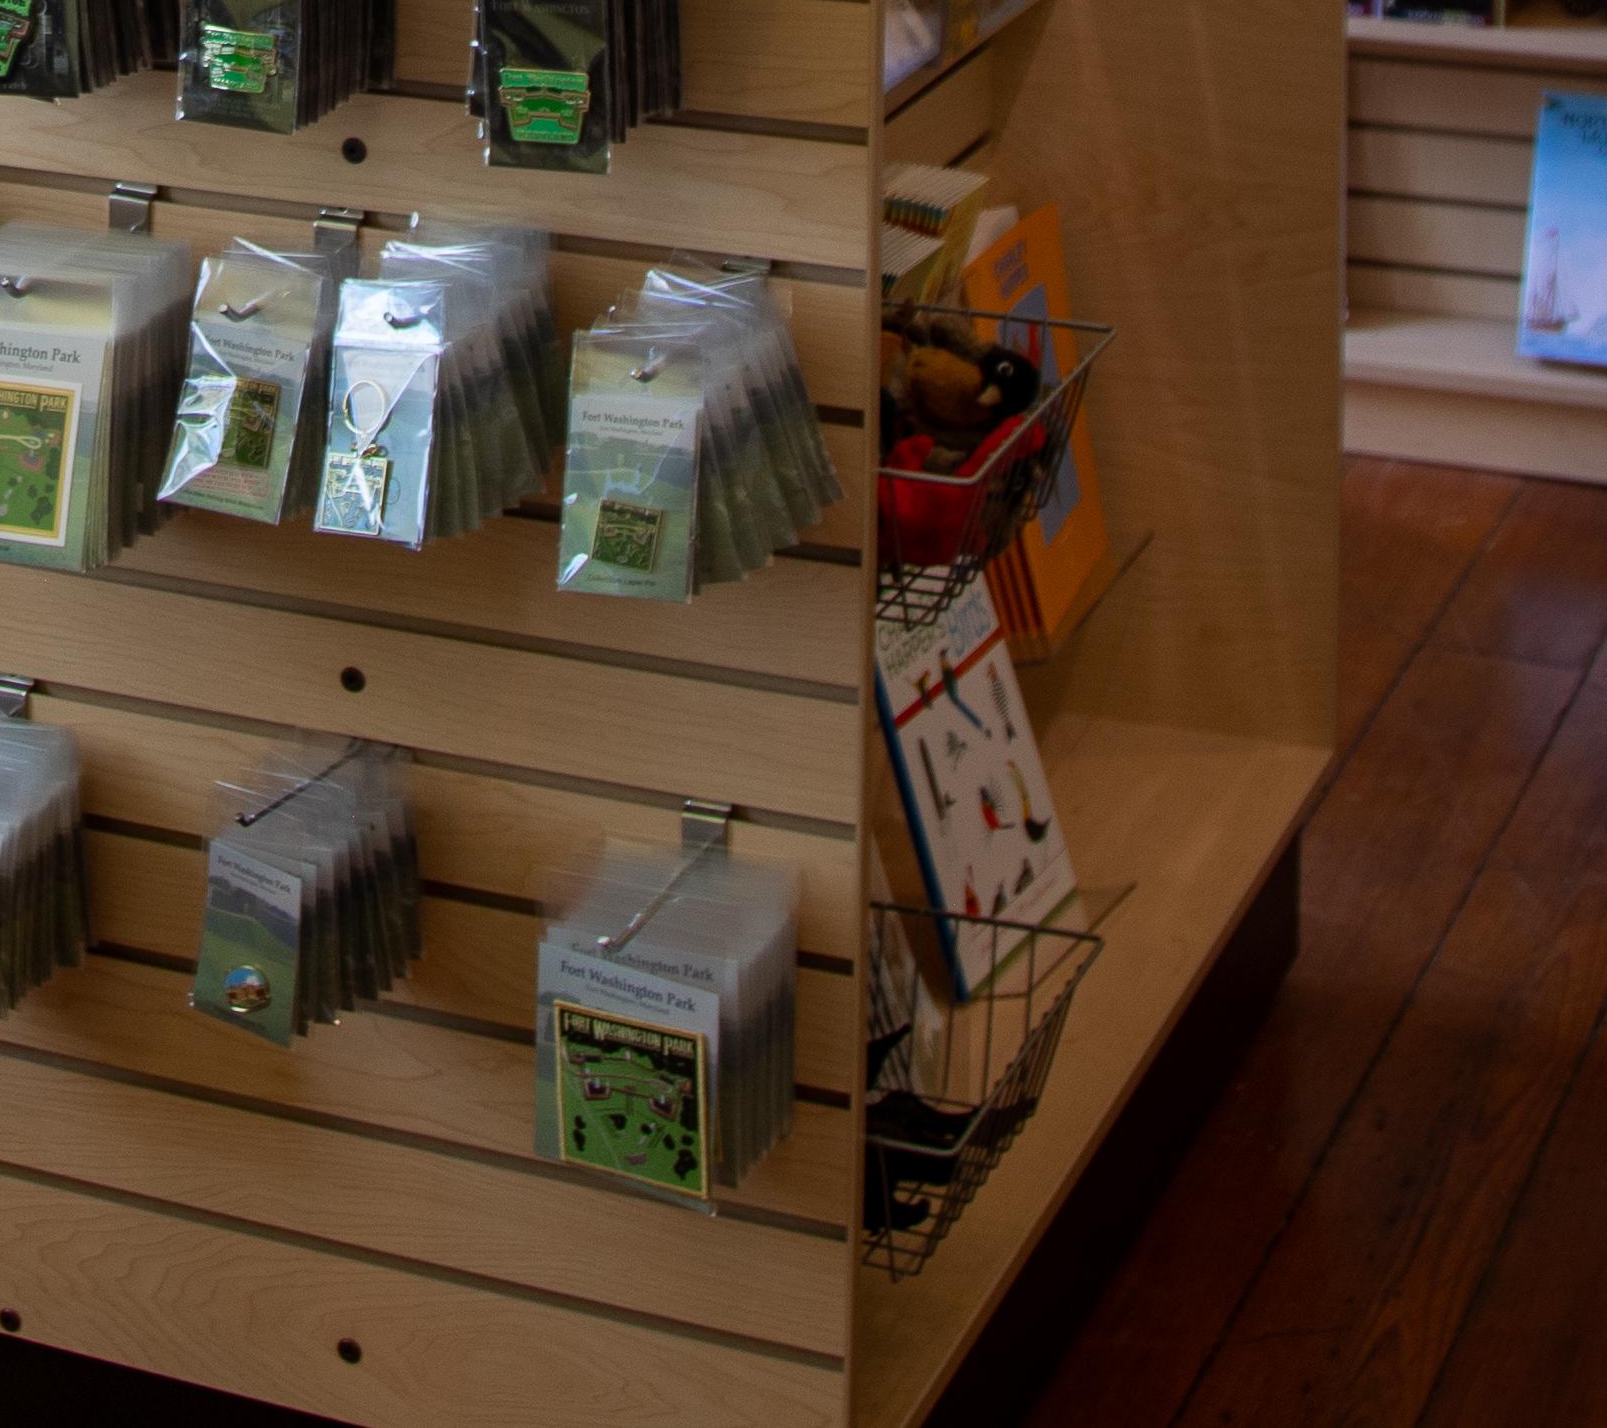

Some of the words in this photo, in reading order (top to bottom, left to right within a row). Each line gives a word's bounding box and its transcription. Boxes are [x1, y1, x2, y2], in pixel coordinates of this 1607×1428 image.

[50, 348, 82, 365] Park
[39, 394, 69, 412] PARK
[582, 410, 602, 424] Fort
[602, 411, 662, 431] Washington
[662, 416, 685, 431] Park
[560, 959, 586, 978] Fort
[587, 967, 664, 1003] Washington
[667, 991, 697, 1014] Park
